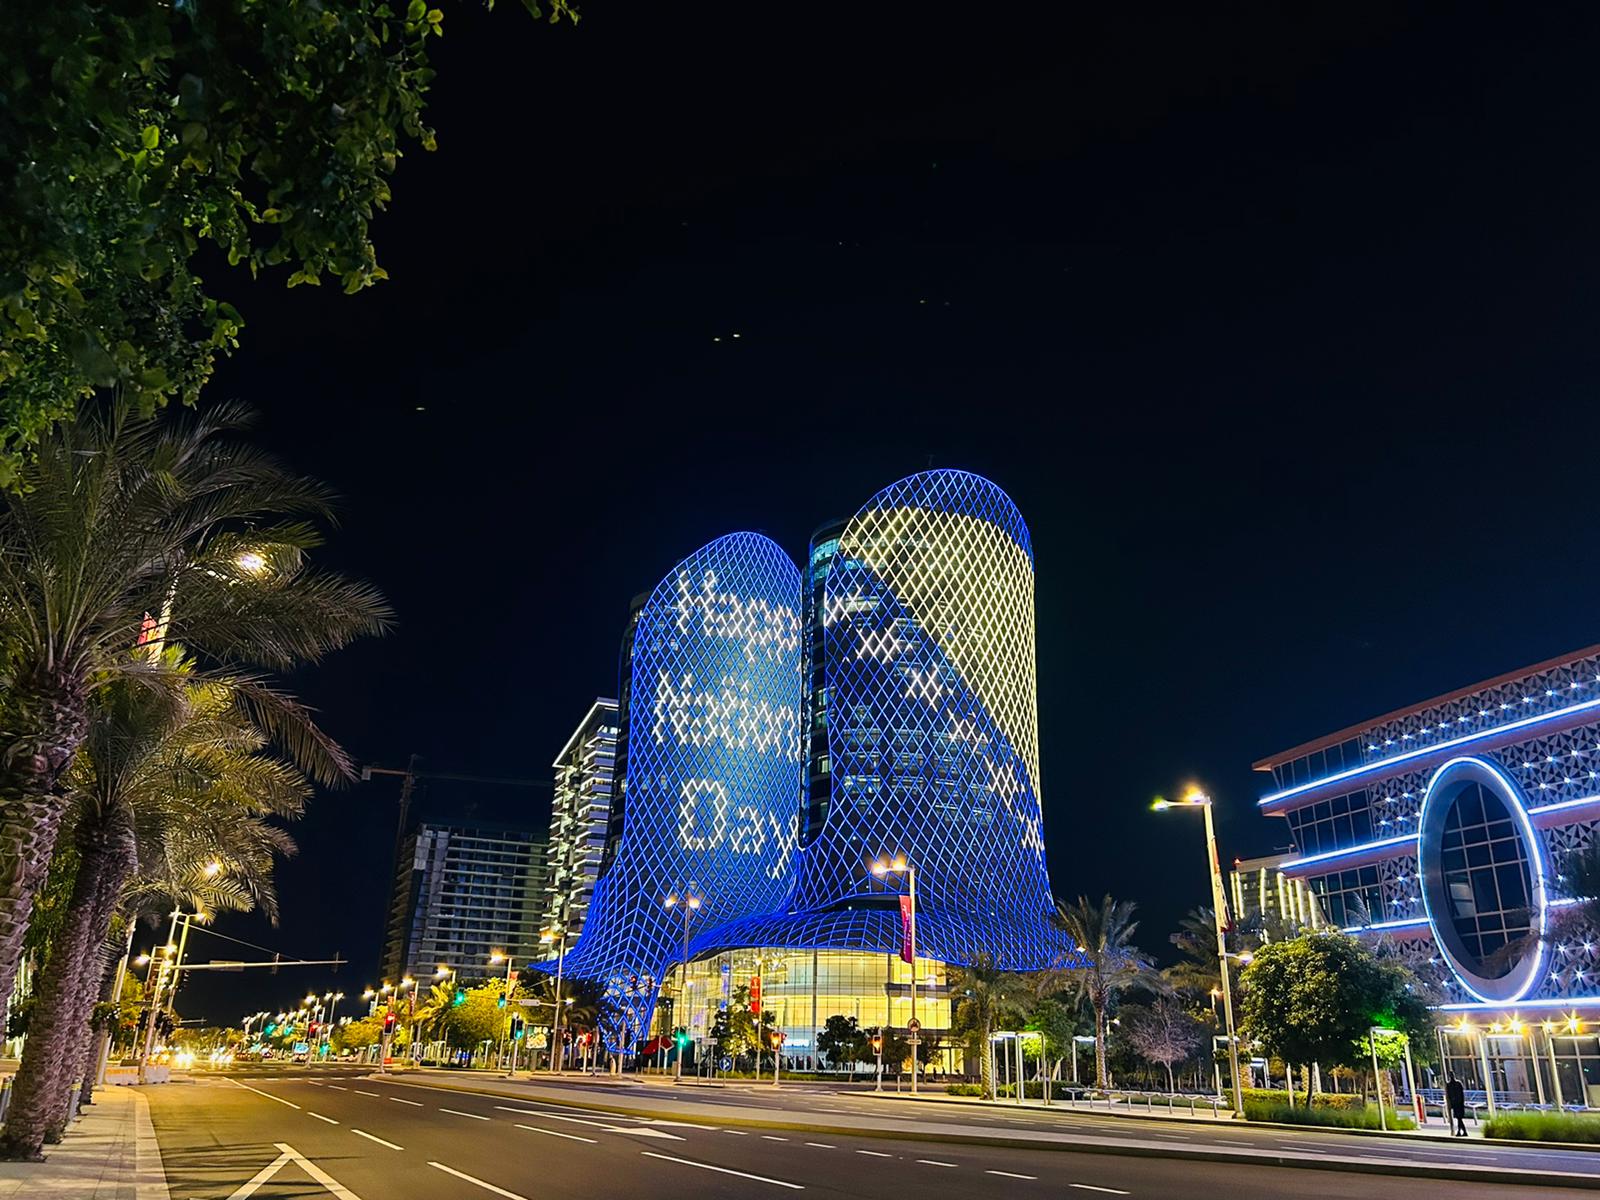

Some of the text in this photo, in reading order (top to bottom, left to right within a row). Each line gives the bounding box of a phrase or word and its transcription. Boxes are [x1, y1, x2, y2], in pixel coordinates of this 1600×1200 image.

[675, 569, 802, 670] Happ
[651, 668, 802, 763] Nation
[677, 778, 799, 880] Day
